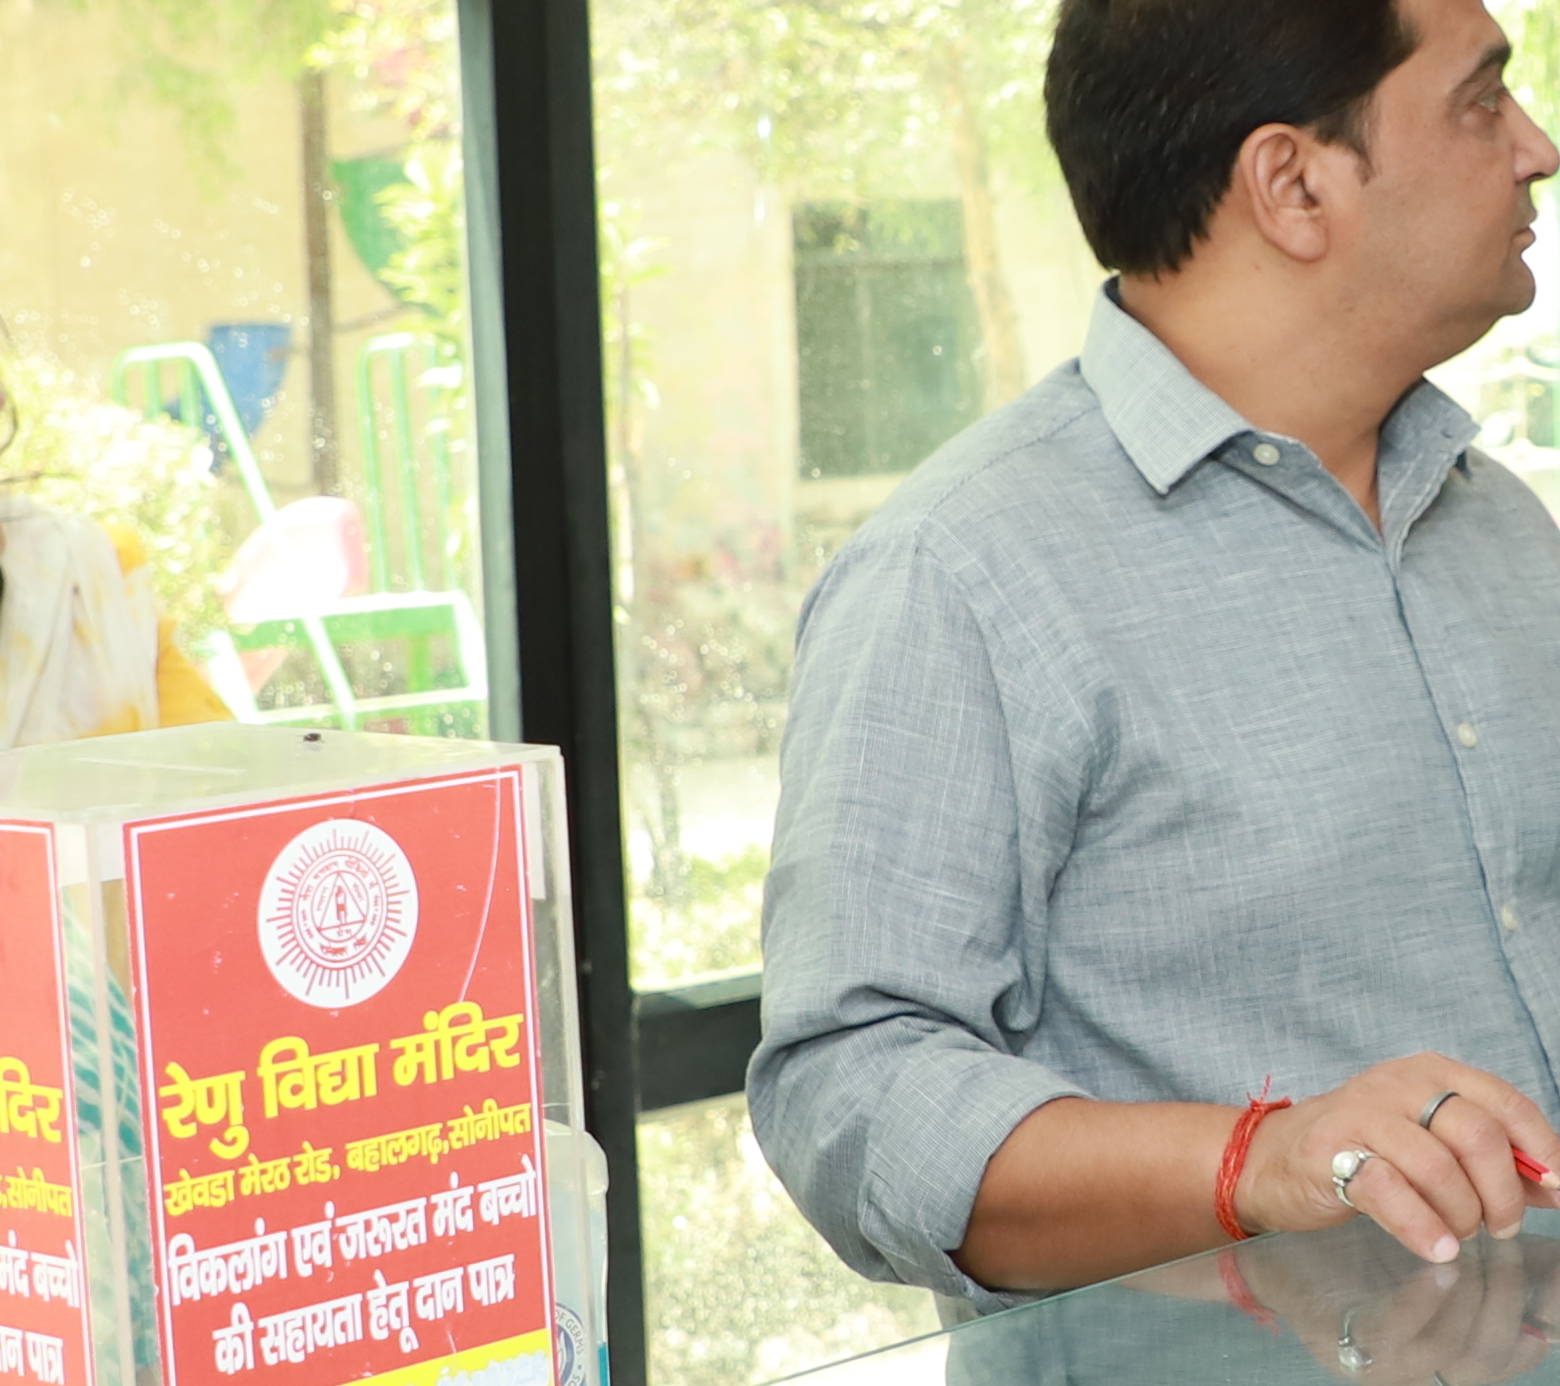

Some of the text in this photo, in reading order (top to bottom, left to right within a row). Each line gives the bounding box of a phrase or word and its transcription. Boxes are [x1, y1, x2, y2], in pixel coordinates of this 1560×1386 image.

[159, 1001, 524, 1160] रेणु विद्या मंदिर
[238, 1152, 292, 1197] मेरठ
[168, 1216, 288, 1307] विकलांग
[291, 1199, 336, 1279] एवं
[335, 1195, 428, 1261] जरूरत
[430, 1170, 475, 1239] मंद
[25, 1330, 65, 1386] पात्र
[212, 1300, 255, 1376] की
[258, 1292, 364, 1366] सहायता
[413, 1265, 465, 1325] दान
[467, 1253, 516, 1308] पात्र
[565, 1317, 586, 1356] GERMS
